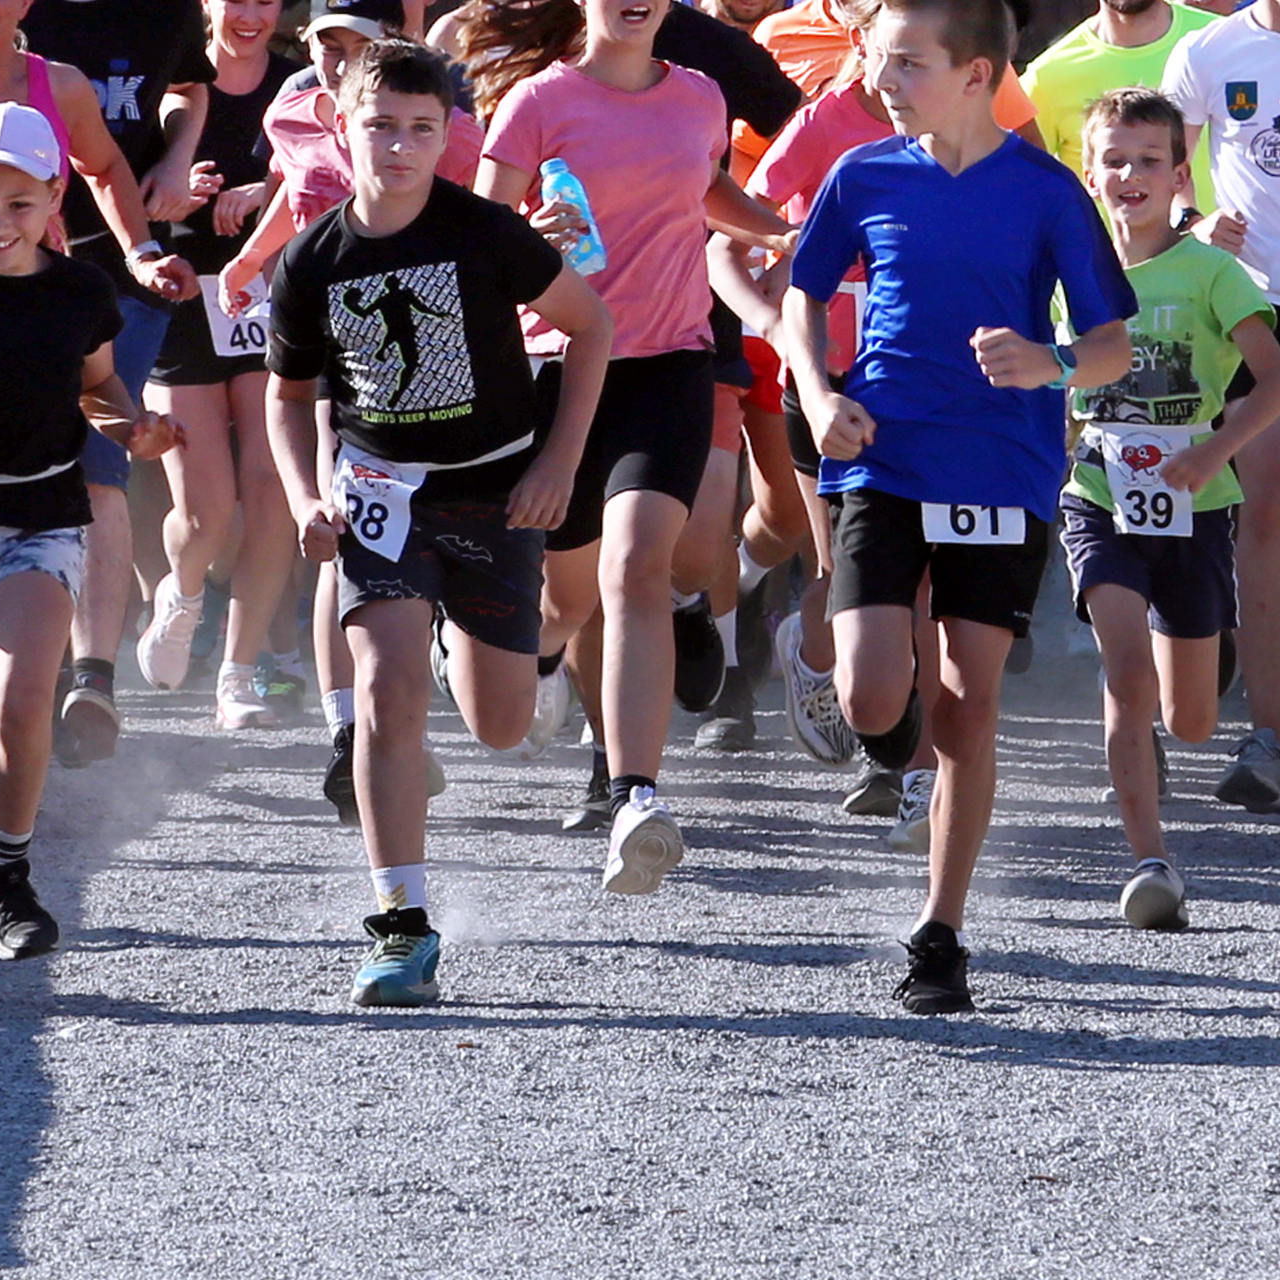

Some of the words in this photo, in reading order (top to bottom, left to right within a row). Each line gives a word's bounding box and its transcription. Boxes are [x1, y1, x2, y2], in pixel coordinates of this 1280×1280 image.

[1154, 305, 1177, 331] IT
[230, 322, 266, 350] 40
[361, 410, 395, 423] ALWAYS
[399, 413, 426, 423] KEEP
[429, 403, 473, 421] MOVING
[949, 505, 999, 536] 61
[1125, 489, 1173, 529] 39
